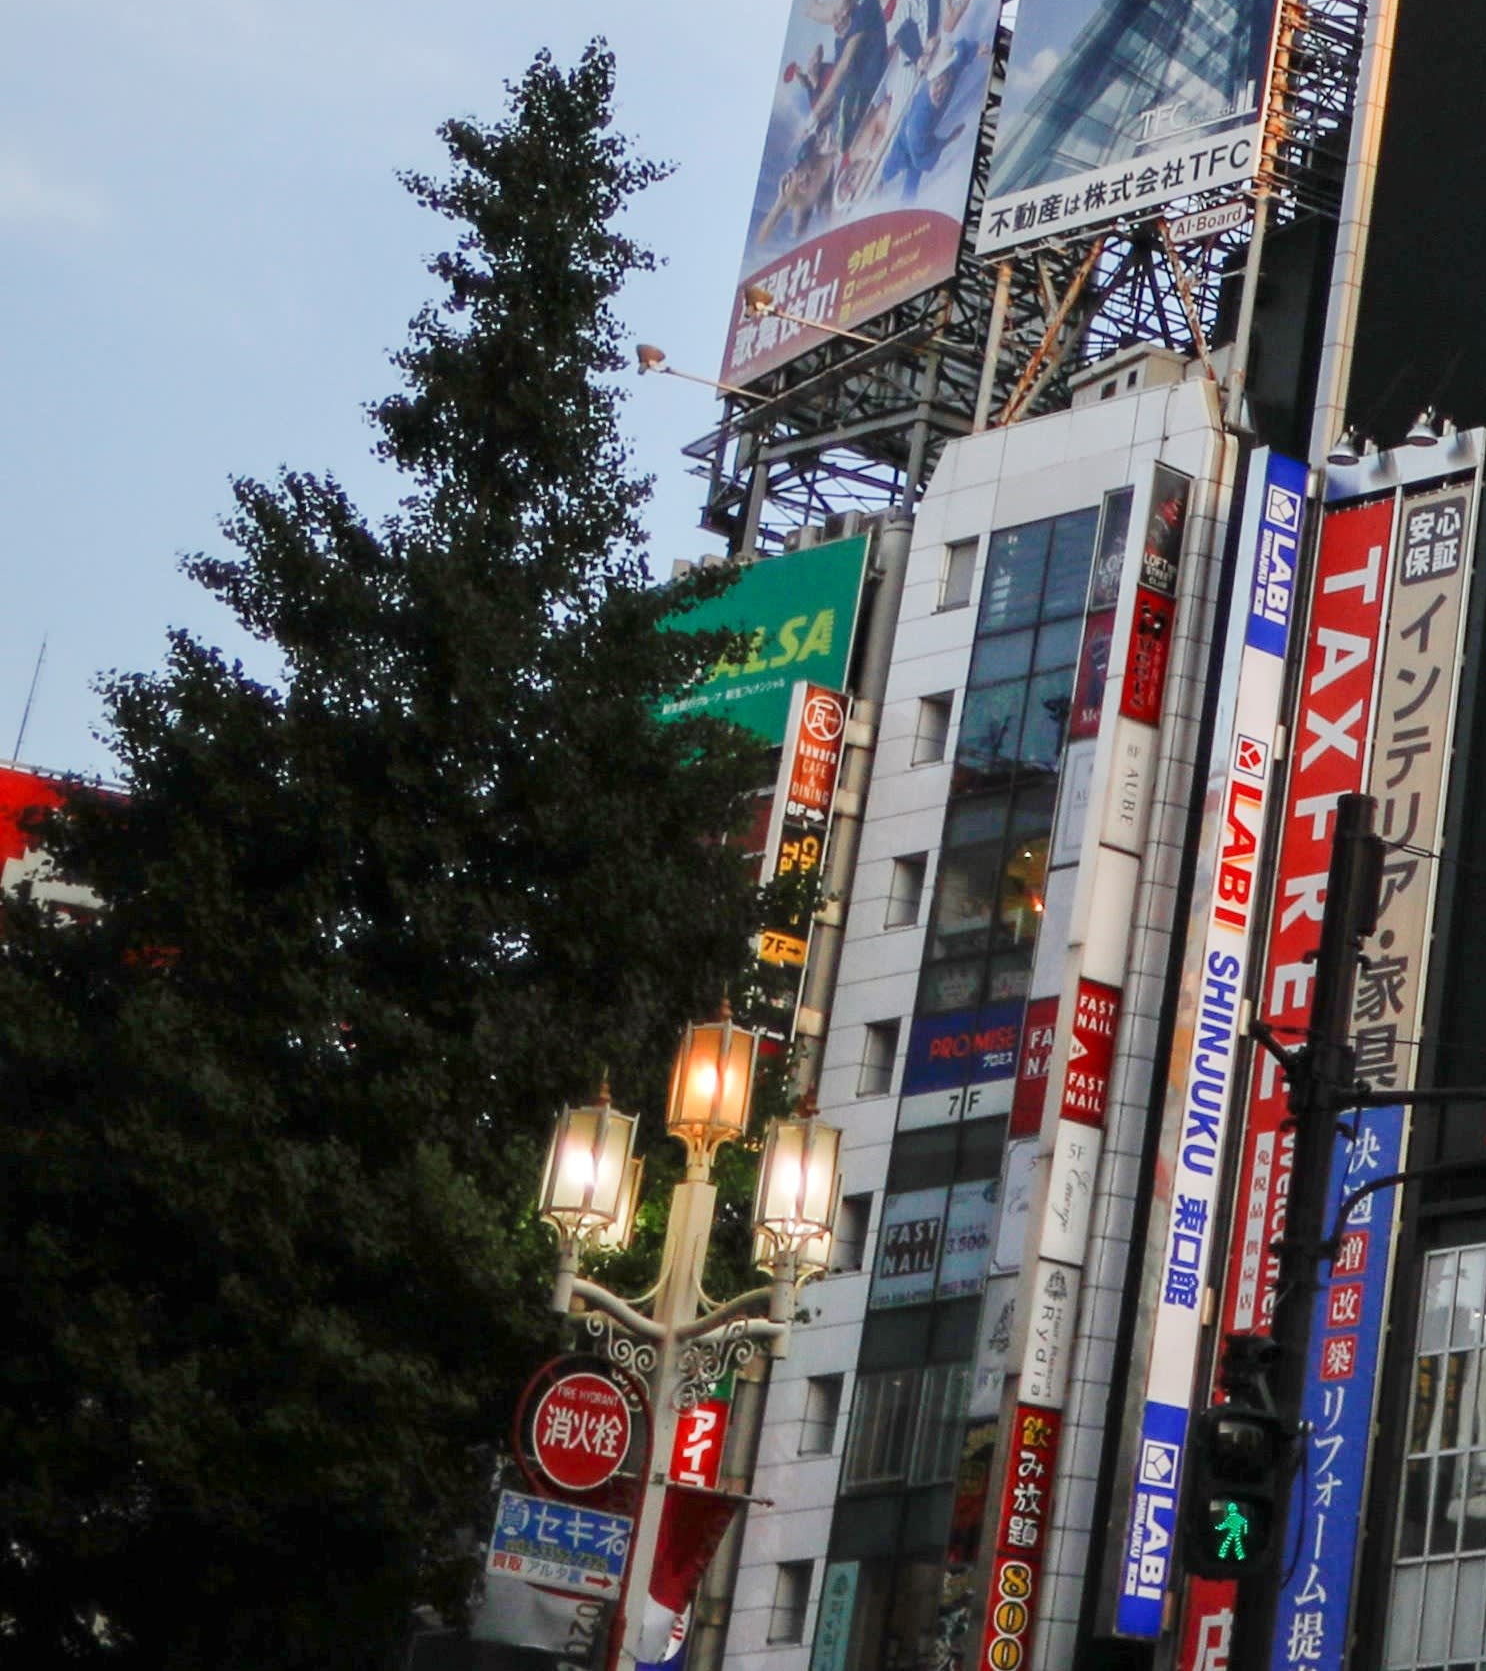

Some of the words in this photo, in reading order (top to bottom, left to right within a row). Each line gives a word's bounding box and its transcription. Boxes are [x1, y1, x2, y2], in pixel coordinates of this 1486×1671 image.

[987, 138, 1253, 238] 不動産は株式会社TFC
[1407, 504, 1463, 541] 安心
[1403, 536, 1459, 579] 保証
[1263, 531, 1296, 627] LABI
[1299, 544, 1382, 770] TAX
[802, 759, 828, 779] CAFE
[786, 802, 806, 818] 8F
[791, 781, 830, 805] DINING
[1120, 770, 1139, 826] AUBE
[1213, 778, 1264, 930] LABI
[763, 934, 785, 953] 7F
[1076, 1013, 1113, 1035] NAIL
[1078, 995, 1116, 1017] FAST
[929, 1025, 1016, 1062] PROMISE
[1030, 1027, 1056, 1049] FA
[982, 1050, 1014, 1068] プロミス
[1026, 1056, 1052, 1076] NA
[1181, 947, 1241, 1177] SHINJUKU
[1067, 1071, 1105, 1092] FAST
[948, 1090, 982, 1117] 7F
[1065, 1089, 1101, 1112] NAIL
[885, 1218, 938, 1246] FAST
[882, 1255, 933, 1275] NAIL
[1163, 1193, 1209, 1311] 東口館
[1029, 1304, 1056, 1397] Rydia
[556, 1385, 578, 1399] FIRE
[578, 1387, 619, 1408] HYDRANT
[1286, 1126, 1381, 1671] 快適増改築リフォーム提
[541, 1403, 623, 1459] 消火栓
[1007, 1414, 1053, 1547] 飲み放題
[534, 1507, 627, 1555] セキネ
[1137, 1493, 1174, 1601] LABI
